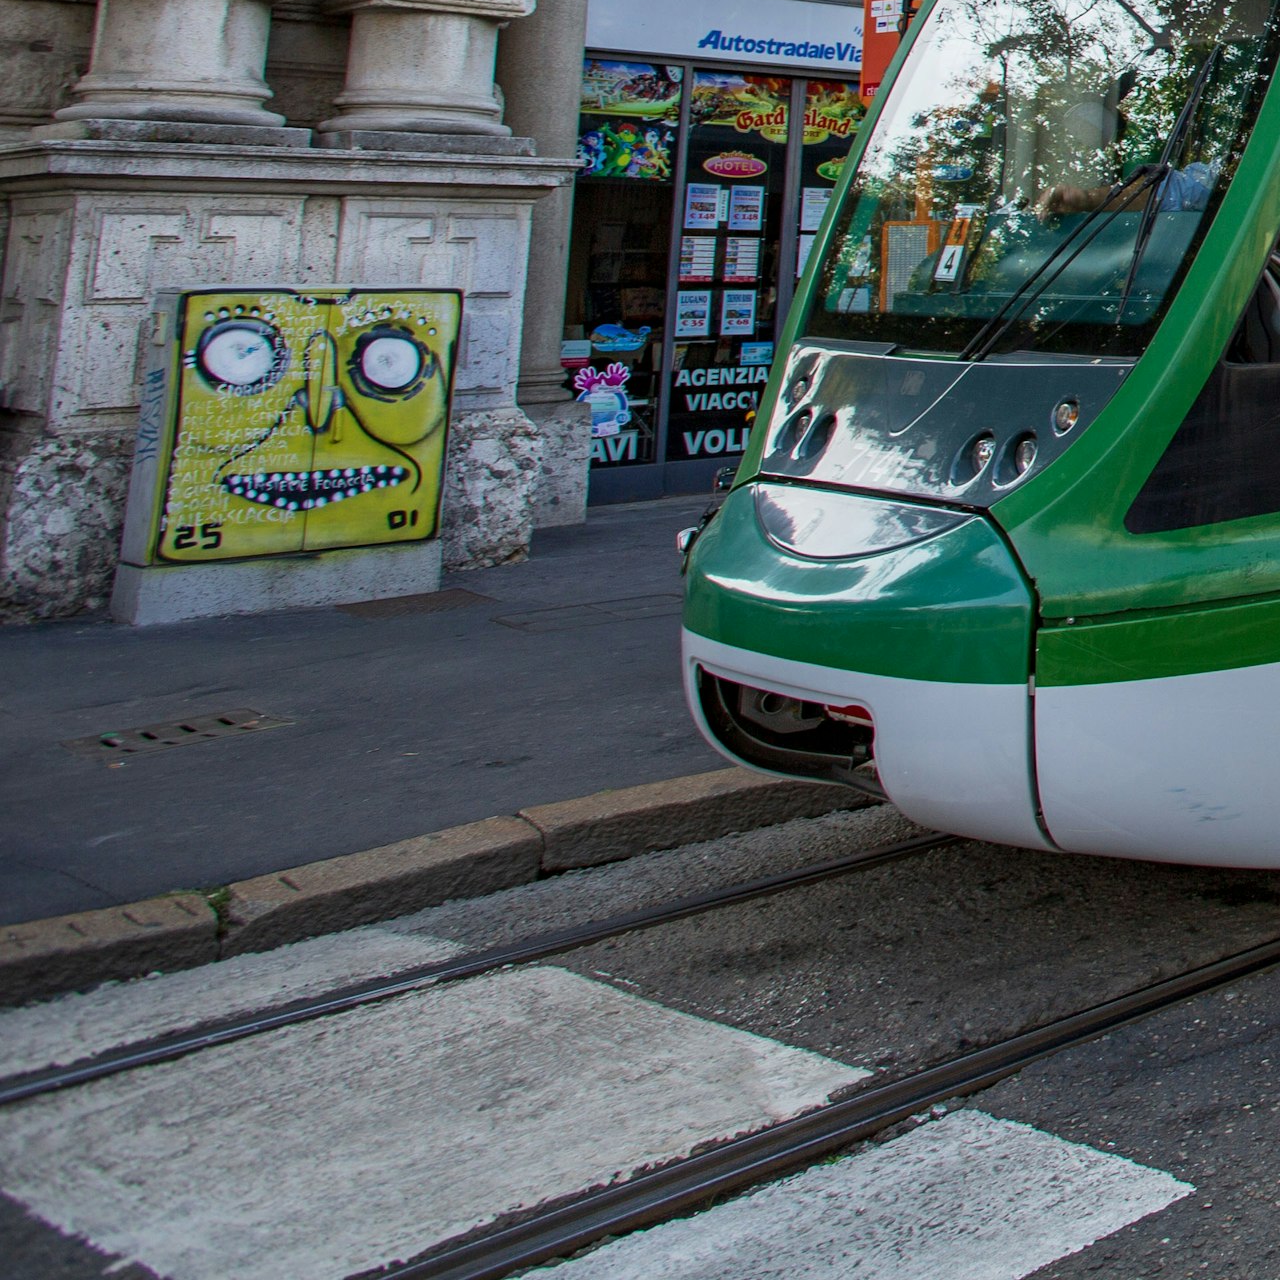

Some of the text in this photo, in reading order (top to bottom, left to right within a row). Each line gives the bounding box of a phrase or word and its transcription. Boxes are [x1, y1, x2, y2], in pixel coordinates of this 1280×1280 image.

[714, 162, 757, 172] HOTEL
[741, 213, 759, 221] 148
[944, 249, 957, 274] 4
[680, 295, 708, 304] LUGANO
[691, 319, 704, 327] 35
[674, 366, 769, 387] AGENZIA
